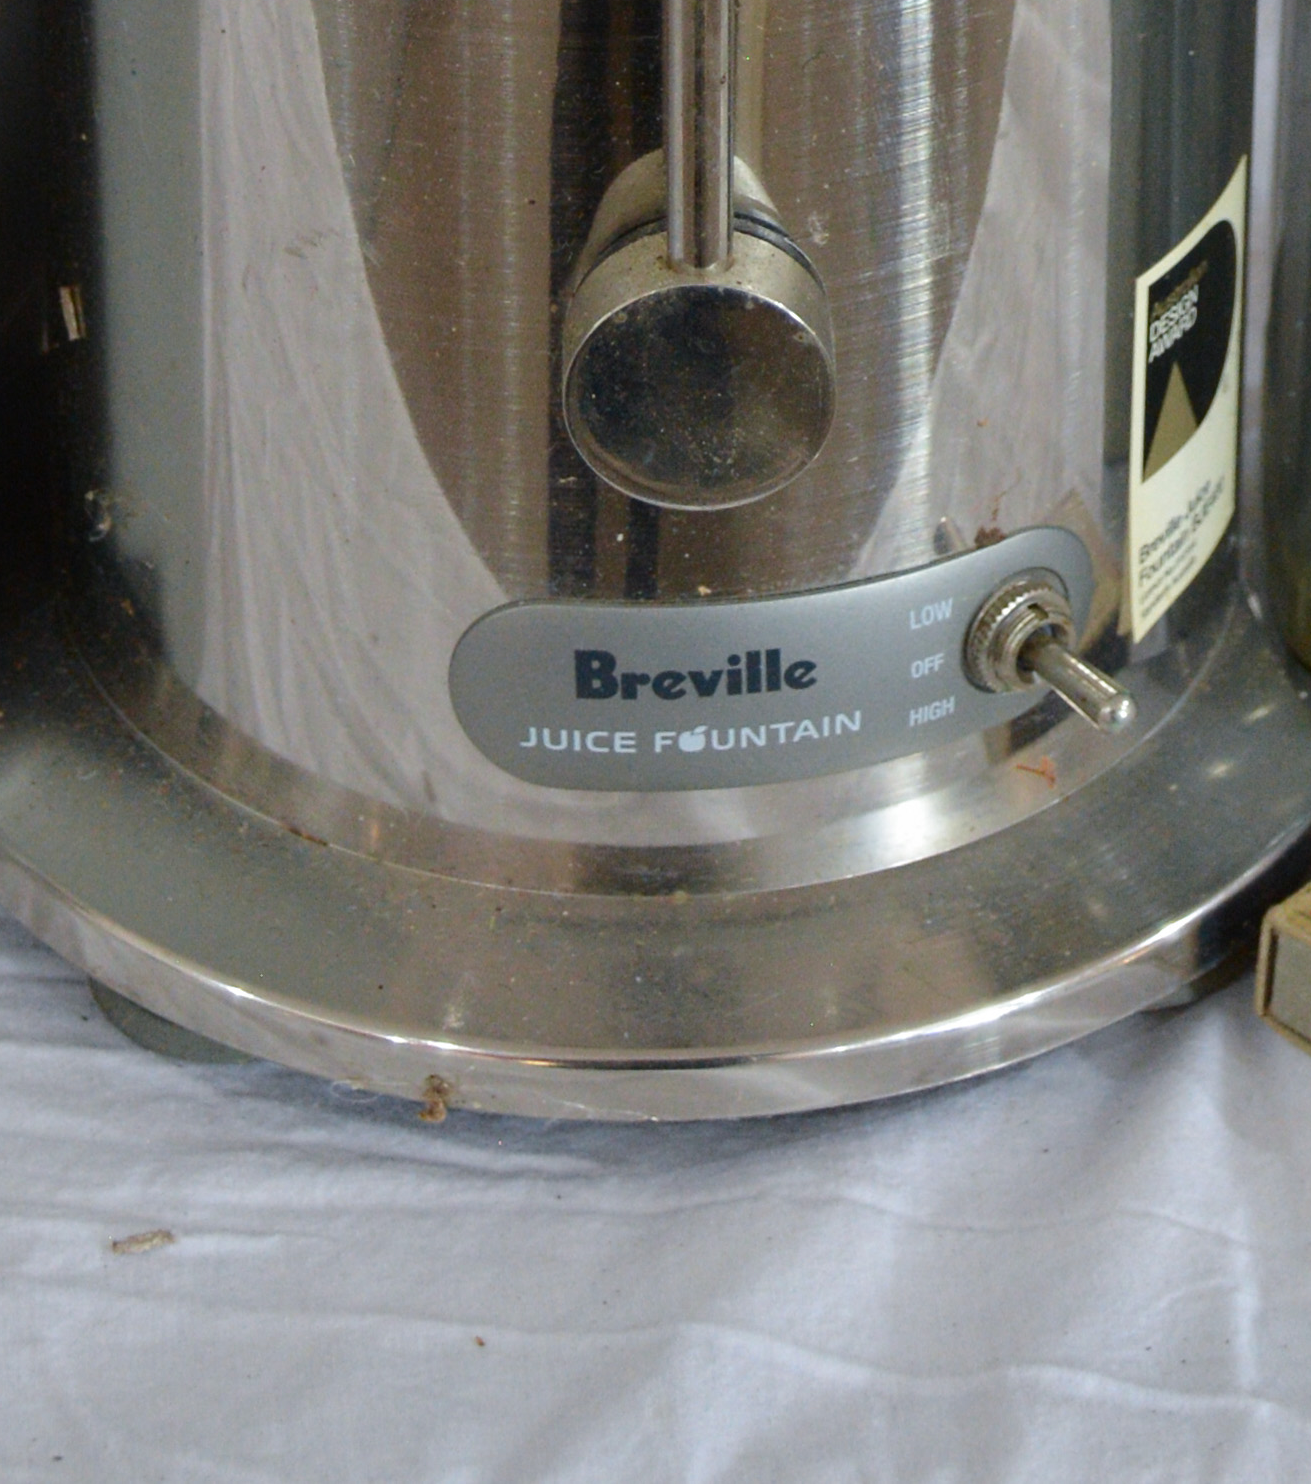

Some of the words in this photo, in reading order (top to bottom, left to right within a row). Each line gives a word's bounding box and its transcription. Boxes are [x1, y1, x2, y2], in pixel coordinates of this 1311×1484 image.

[1149, 284, 1199, 343] DESIGN
[909, 597, 953, 630] LOW
[574, 648, 817, 700] Breville
[911, 653, 944, 678] OFF
[909, 696, 955, 727] HIGH
[519, 726, 638, 754] JUICE
